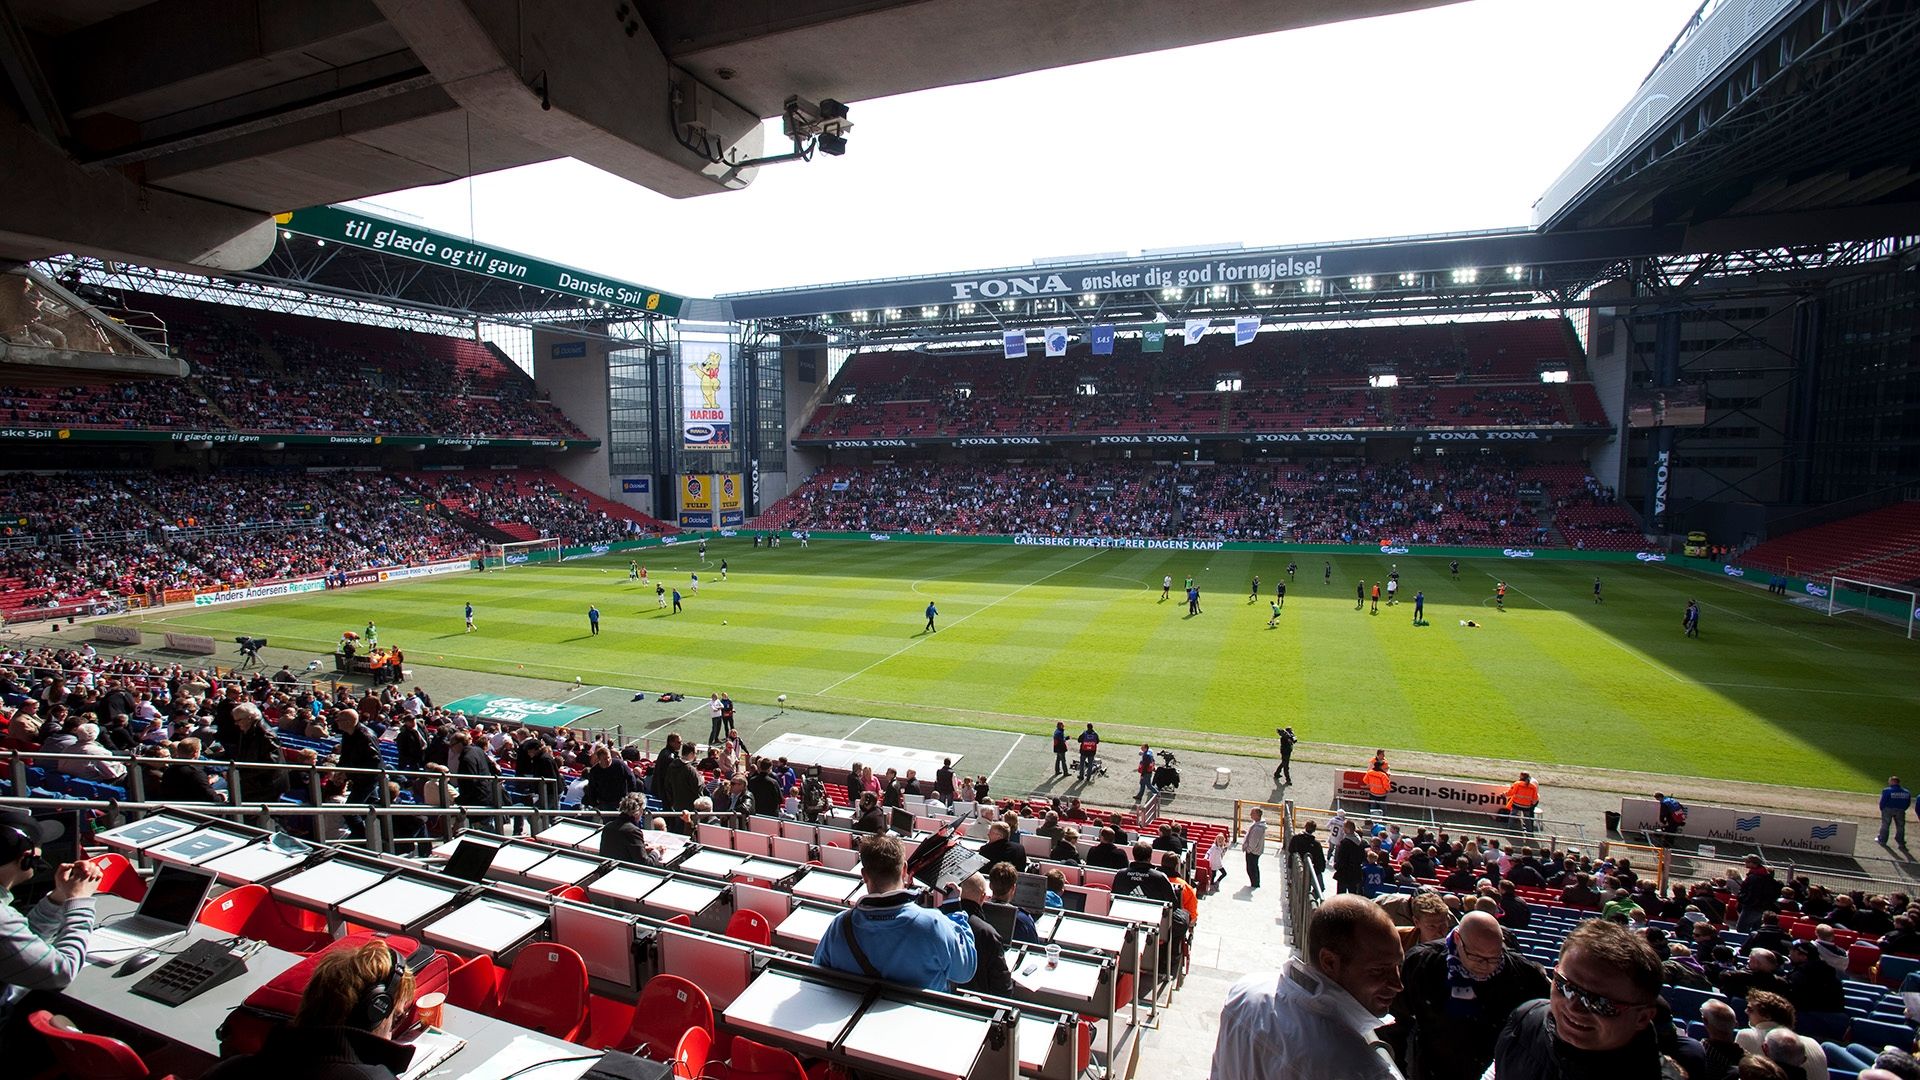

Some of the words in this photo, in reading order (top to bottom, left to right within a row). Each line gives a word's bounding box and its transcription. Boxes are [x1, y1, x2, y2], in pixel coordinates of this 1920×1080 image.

[344, 219, 372, 242] til
[373, 229, 437, 256] glæde
[440, 246, 465, 265] og
[465, 249, 488, 268] til
[487, 257, 528, 278] gavn
[951, 273, 1073, 300] FONA
[1081, 270, 1140, 291] ønsker
[1144, 267, 1173, 287] dig
[1177, 262, 1212, 286] god
[1217, 255, 1323, 282] fornøjelse!
[558, 273, 614, 298] Danske
[615, 288, 642, 305] Spil
[1096, 336, 1110, 344] SAS
[690, 410, 724, 420] HARIBO
[28, 429, 52, 439] Spil
[171, 432, 183, 440] til
[184, 433, 213, 442] glæde
[214, 434, 226, 442] og
[227, 433, 238, 441] til
[239, 434, 260, 443] gavn
[357, 436, 372, 444] Spil
[1100, 435, 1142, 443] FONA
[1308, 433, 1355, 441] FONA
[1428, 432, 1480, 440] FONA
[1486, 431, 1539, 439] FONA
[835, 440, 869, 448] FONA
[751, 458, 759, 505] FONA
[1654, 450, 1669, 517] FONA
[1014, 537, 1070, 546] CARLSBERG
[1148, 540, 1190, 550] DAGENS
[1192, 541, 1224, 550] KAMP
[214, 590, 244, 603] Anders
[246, 585, 288, 599] Andersen's
[1389, 781, 1511, 806] Scan-Shippin
[1332, 826, 1340, 837] 9
[1707, 829, 1756, 842] MultiLine
[1781, 838, 1831, 851] MultiLine
[1368, 873, 1381, 885] 23
